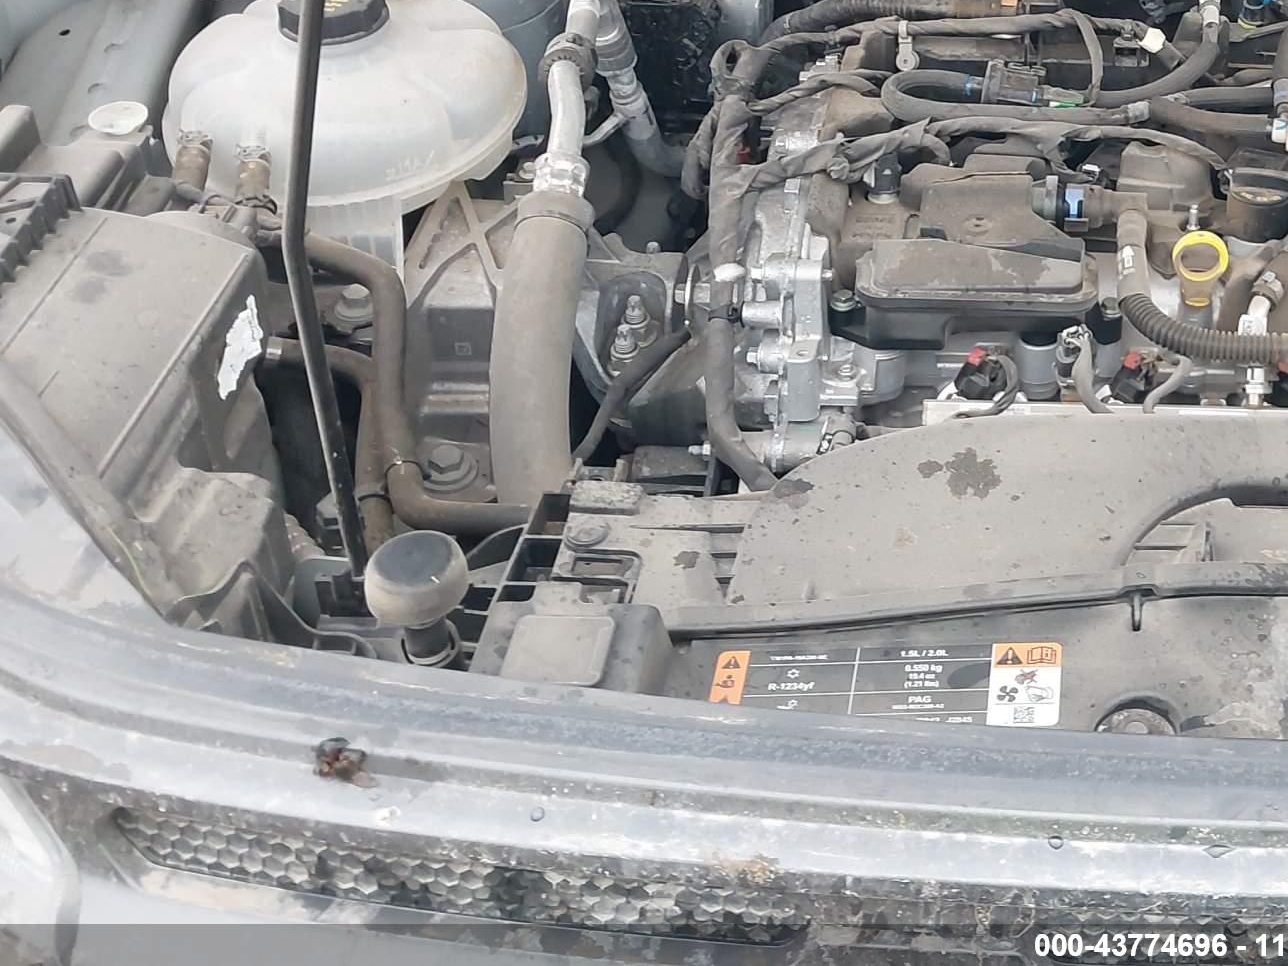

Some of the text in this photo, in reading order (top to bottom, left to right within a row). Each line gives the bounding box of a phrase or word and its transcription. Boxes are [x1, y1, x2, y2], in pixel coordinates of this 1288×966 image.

[930, 664, 943, 673] kg
[767, 681, 816, 692] R-1234yf
[908, 695, 932, 704] PAG
